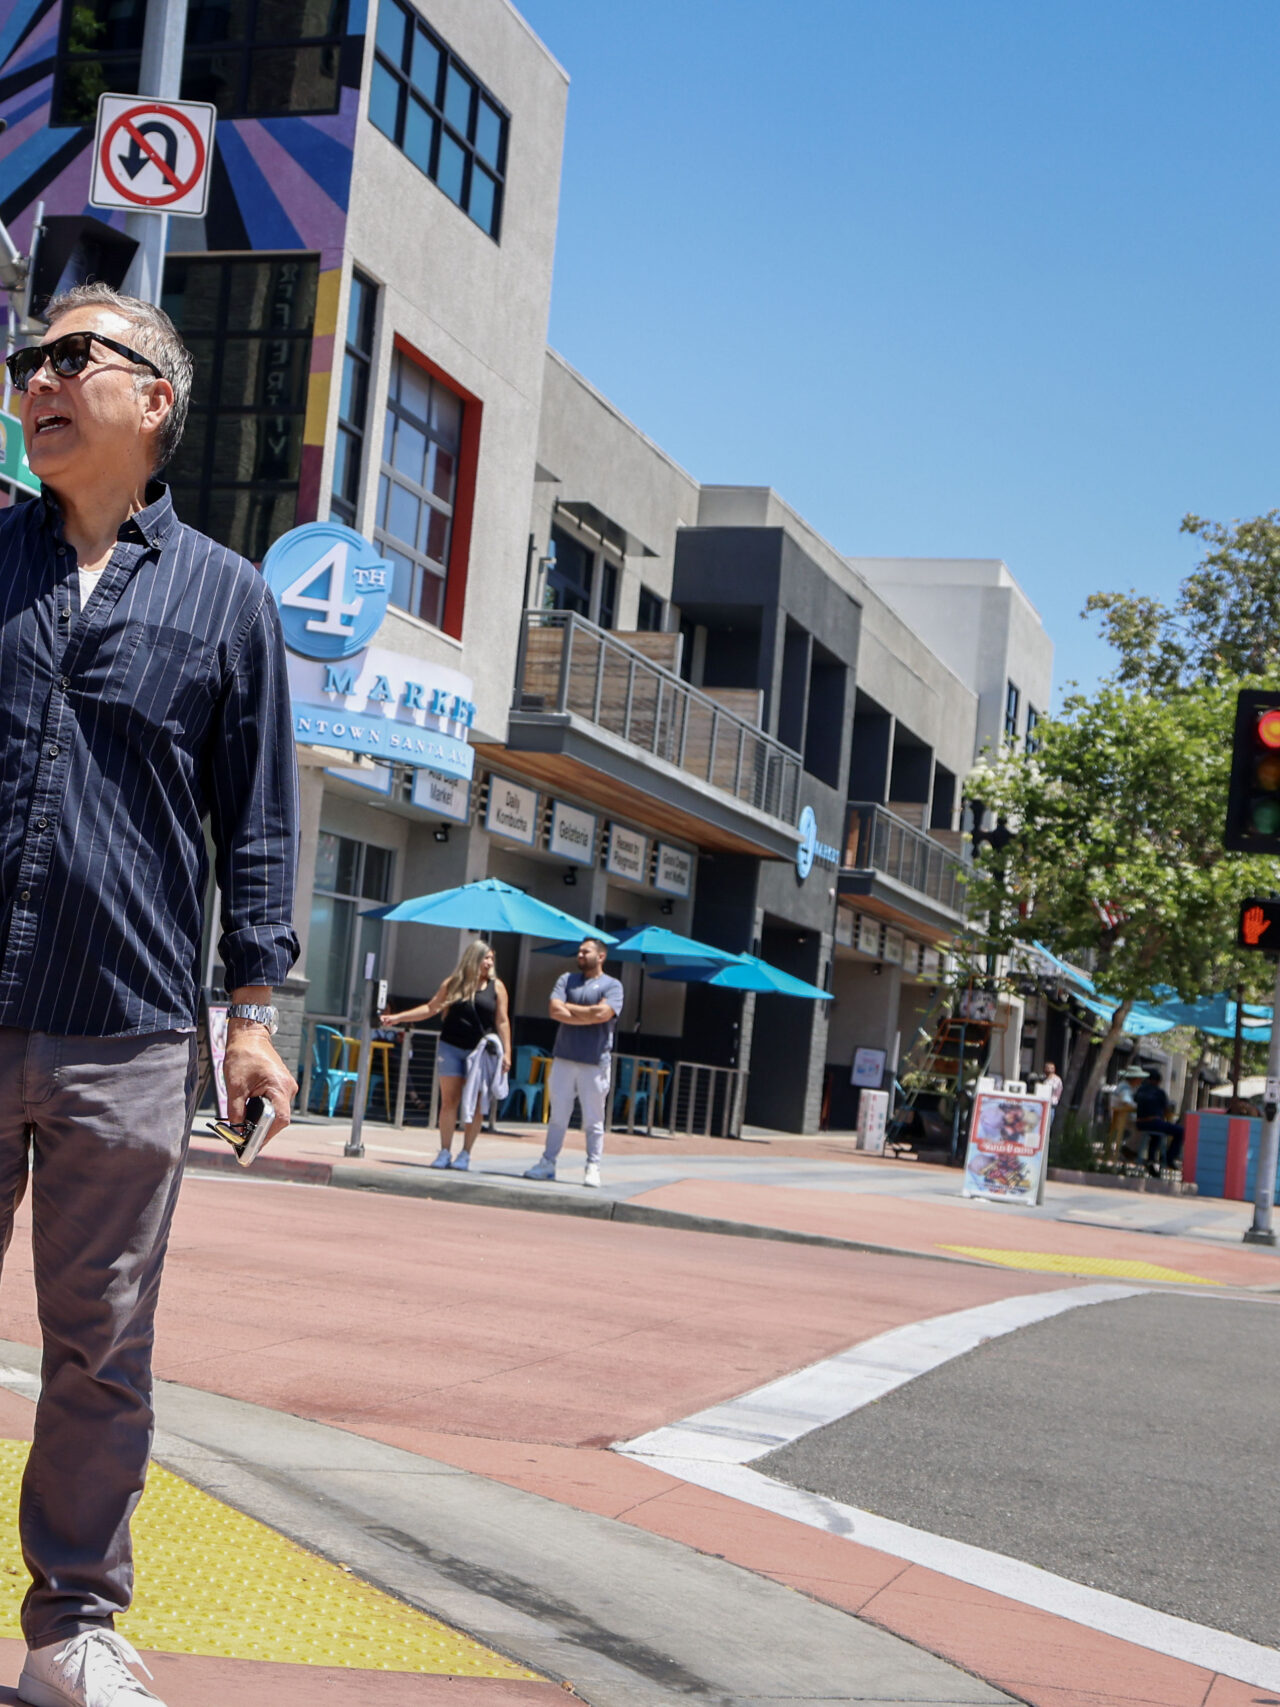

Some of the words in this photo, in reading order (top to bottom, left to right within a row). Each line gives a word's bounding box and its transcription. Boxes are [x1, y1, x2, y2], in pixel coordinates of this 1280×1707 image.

[323, 664, 477, 728] MARKET
[298, 718, 382, 743] NTOWN
[390, 734, 443, 759] SANTA
[430, 783, 453, 806] Market
[506, 791, 520, 814] Daily
[559, 821, 589, 849] Gelateria
